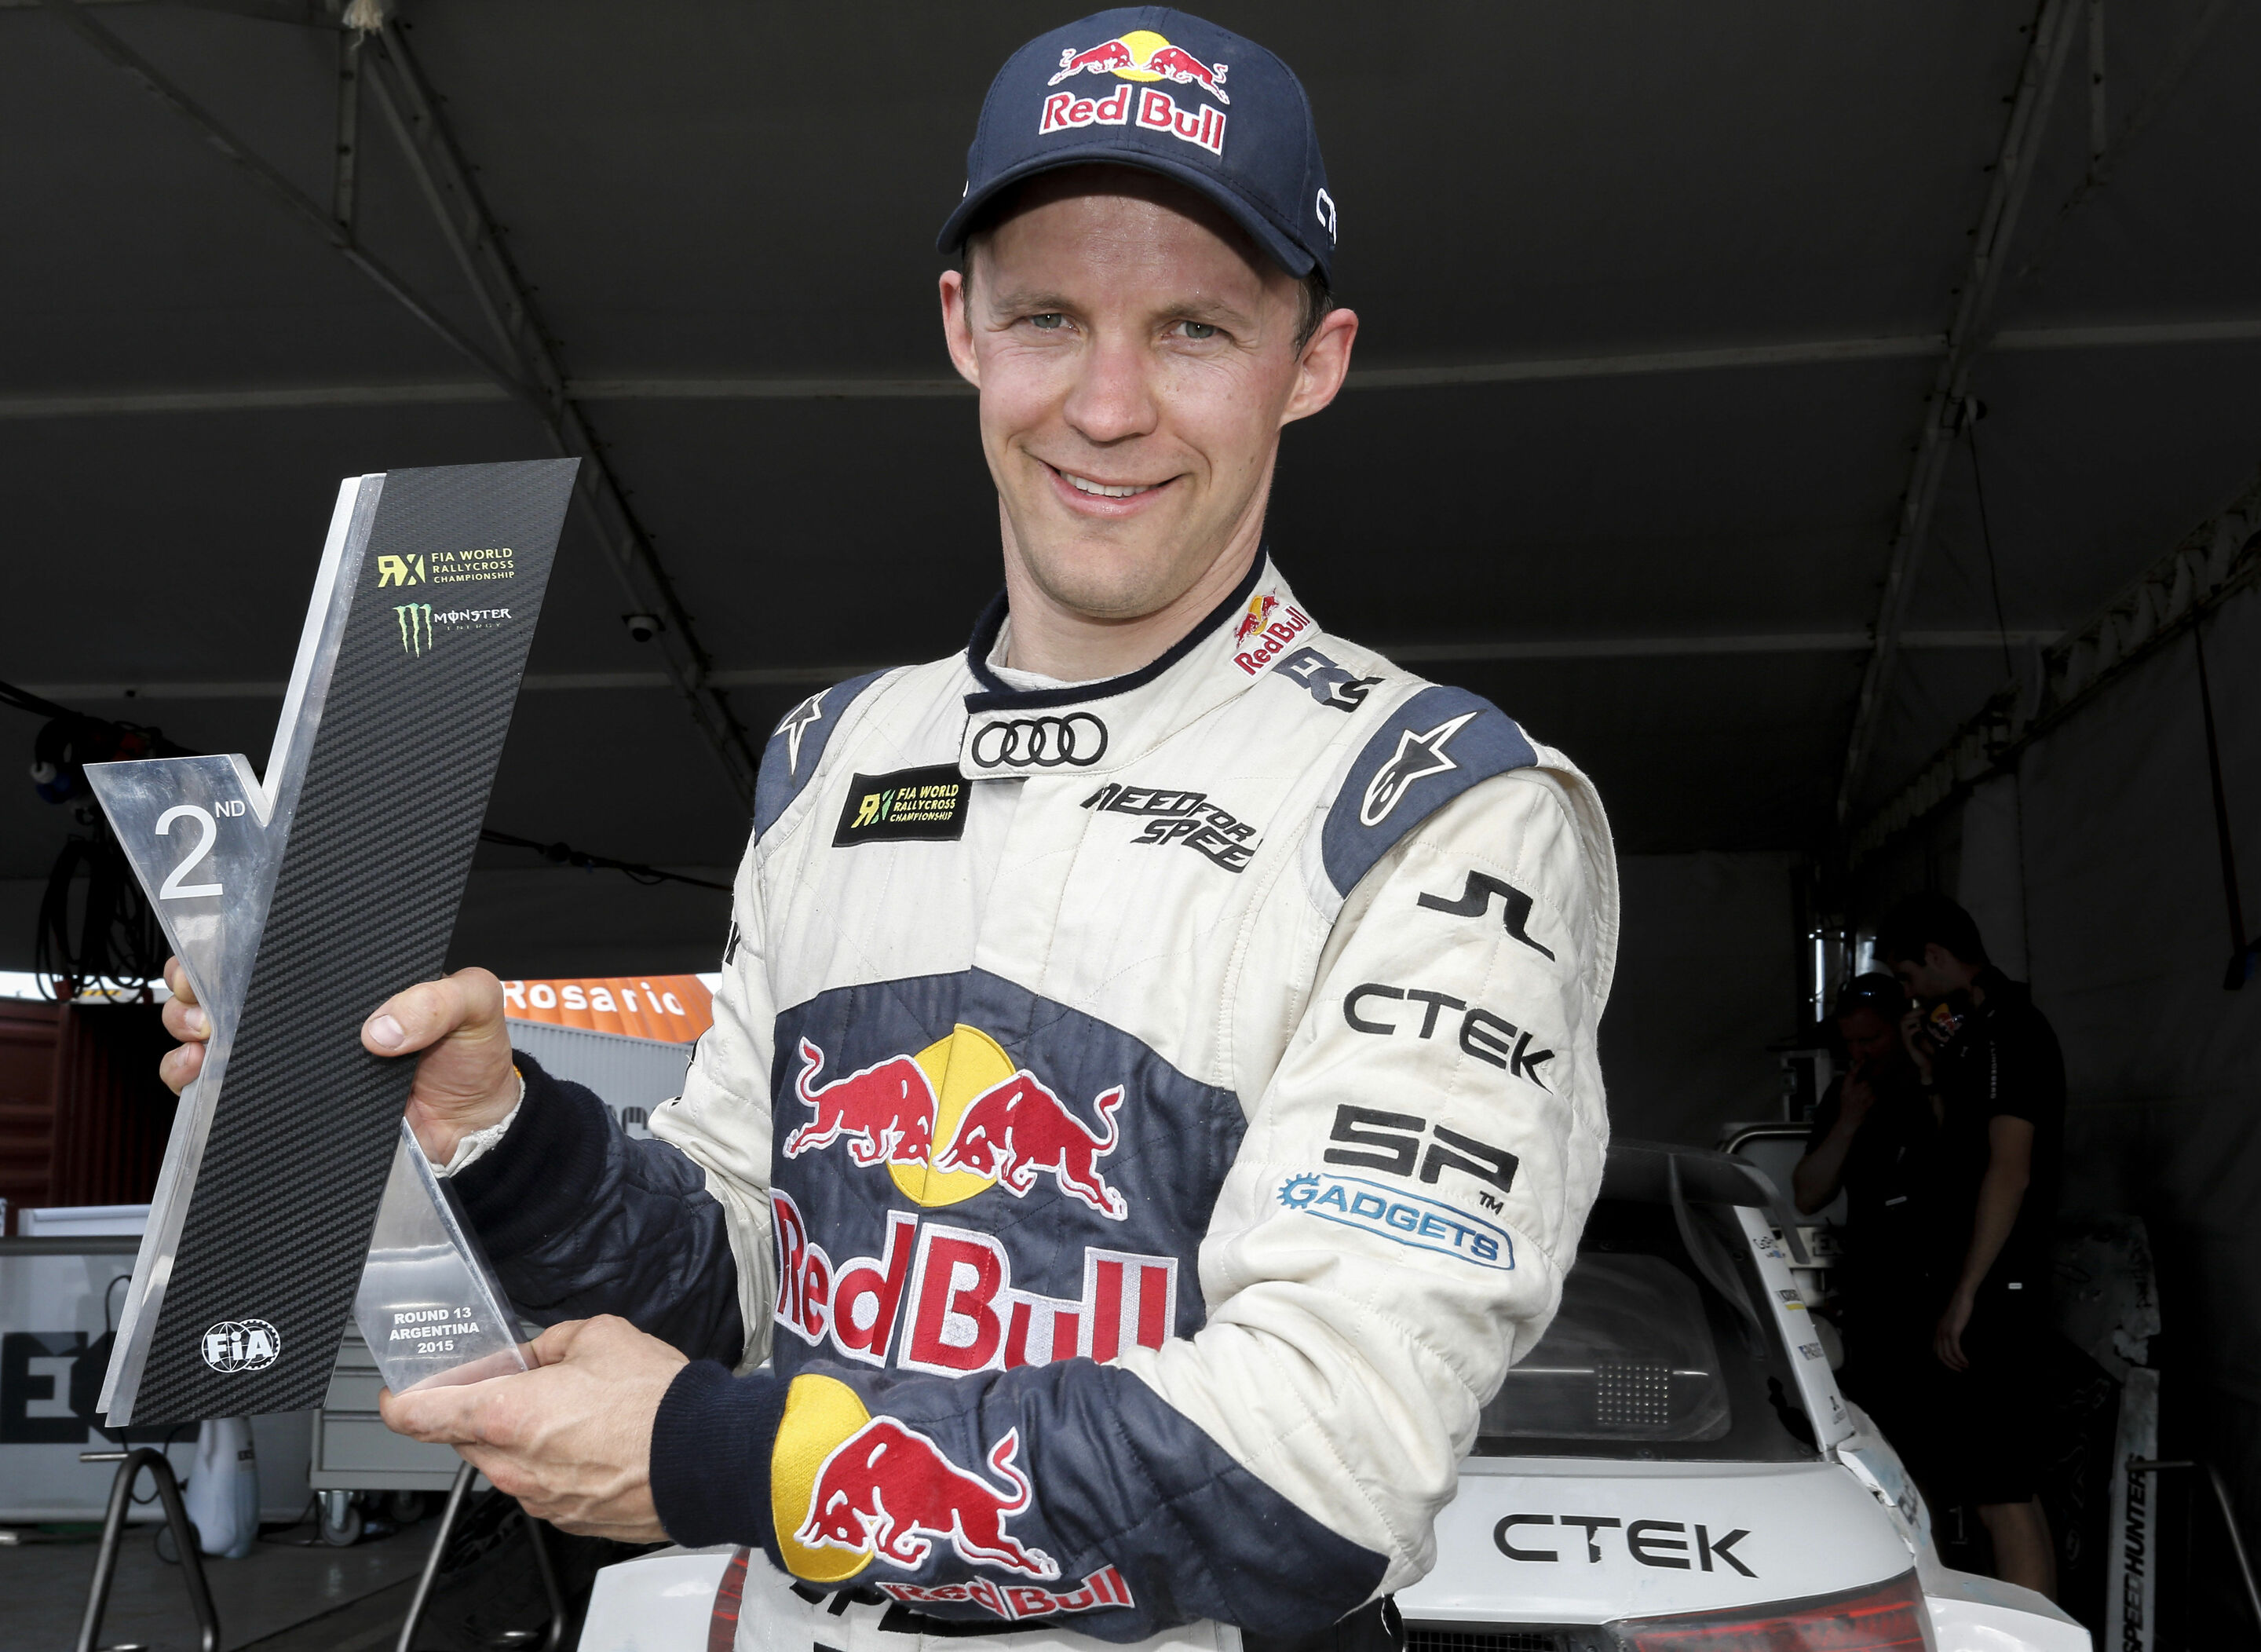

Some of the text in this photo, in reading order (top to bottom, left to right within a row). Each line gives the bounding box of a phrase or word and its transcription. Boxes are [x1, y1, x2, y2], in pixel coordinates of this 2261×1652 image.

[1040, 86, 1225, 154] Red Bull
[432, 552, 455, 563] FIA
[459, 548, 513, 561] WORLD
[433, 560, 514, 574] RALLYCROSS
[433, 571, 515, 583] CHAMPIONSHIP
[1232, 605, 1312, 678] Red Bull
[889, 811, 953, 822] CHAMPIONSHIP
[893, 799, 956, 812] RALLYCROSS
[897, 787, 917, 800] FIA
[919, 784, 959, 799] WORLD
[1079, 783, 1257, 842] NEED FOR
[1130, 819, 1263, 873] SPEE
[1343, 982, 1555, 1095] CTEK
[1324, 1103, 1520, 1193] SP
[1284, 1176, 1499, 1262] GADGETS
[771, 1189, 1176, 1376] Red Bull
[389, 1321, 480, 1341] ARGENTINA
[394, 1307, 472, 1325] ROUND 13
[418, 1340, 454, 1354] 2015
[1492, 1513, 1758, 1578] CTEK
[877, 1576, 1010, 1619] Red
[1000, 1565, 1134, 1620] Bull
